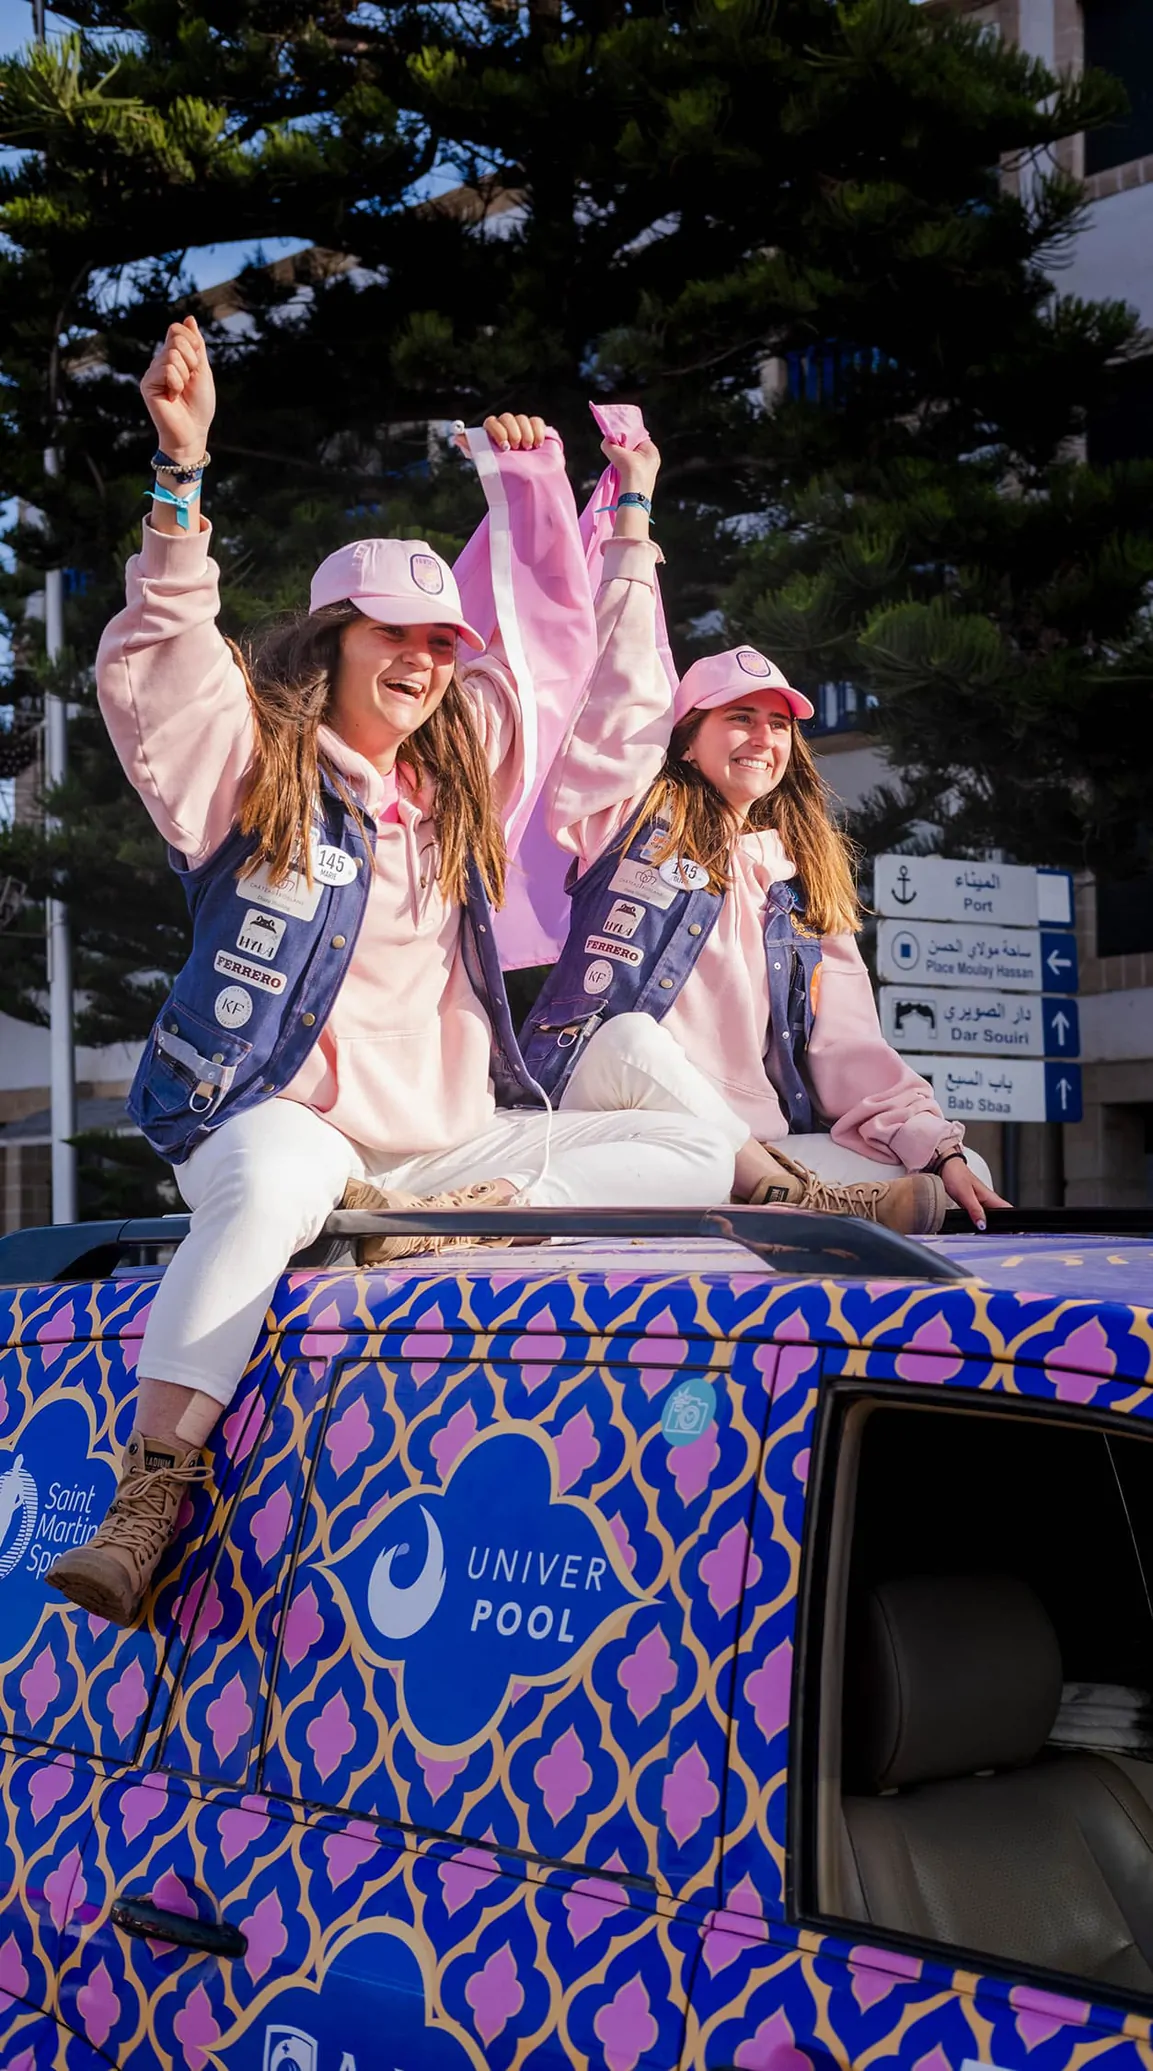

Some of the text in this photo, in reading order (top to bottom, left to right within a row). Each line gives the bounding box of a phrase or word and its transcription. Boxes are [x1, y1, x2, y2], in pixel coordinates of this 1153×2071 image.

[318, 850, 346, 873] 145
[671, 862, 698, 880] 145
[955, 871, 1000, 892] الميناء
[964, 897, 993, 913] Port
[586, 940, 639, 961] FERRERO
[928, 938, 1031, 960] ساحة مولاي الحسن
[216, 955, 281, 988] FERRERO
[588, 970, 606, 983] KF
[926, 959, 1034, 979] Place Moulay Hassan
[221, 998, 245, 1015] KF
[944, 1002, 1031, 1025] دار الصويري
[951, 1026, 1030, 1045] Dar Souiri
[945, 1070, 1012, 1094] باب السبع
[947, 1095, 1011, 1113] Bab Sbaa
[45, 1482, 95, 1513] Saint
[35, 1513, 98, 1545] Martin
[468, 1546, 606, 1591] UNIVER
[470, 1599, 574, 1643] POOL
